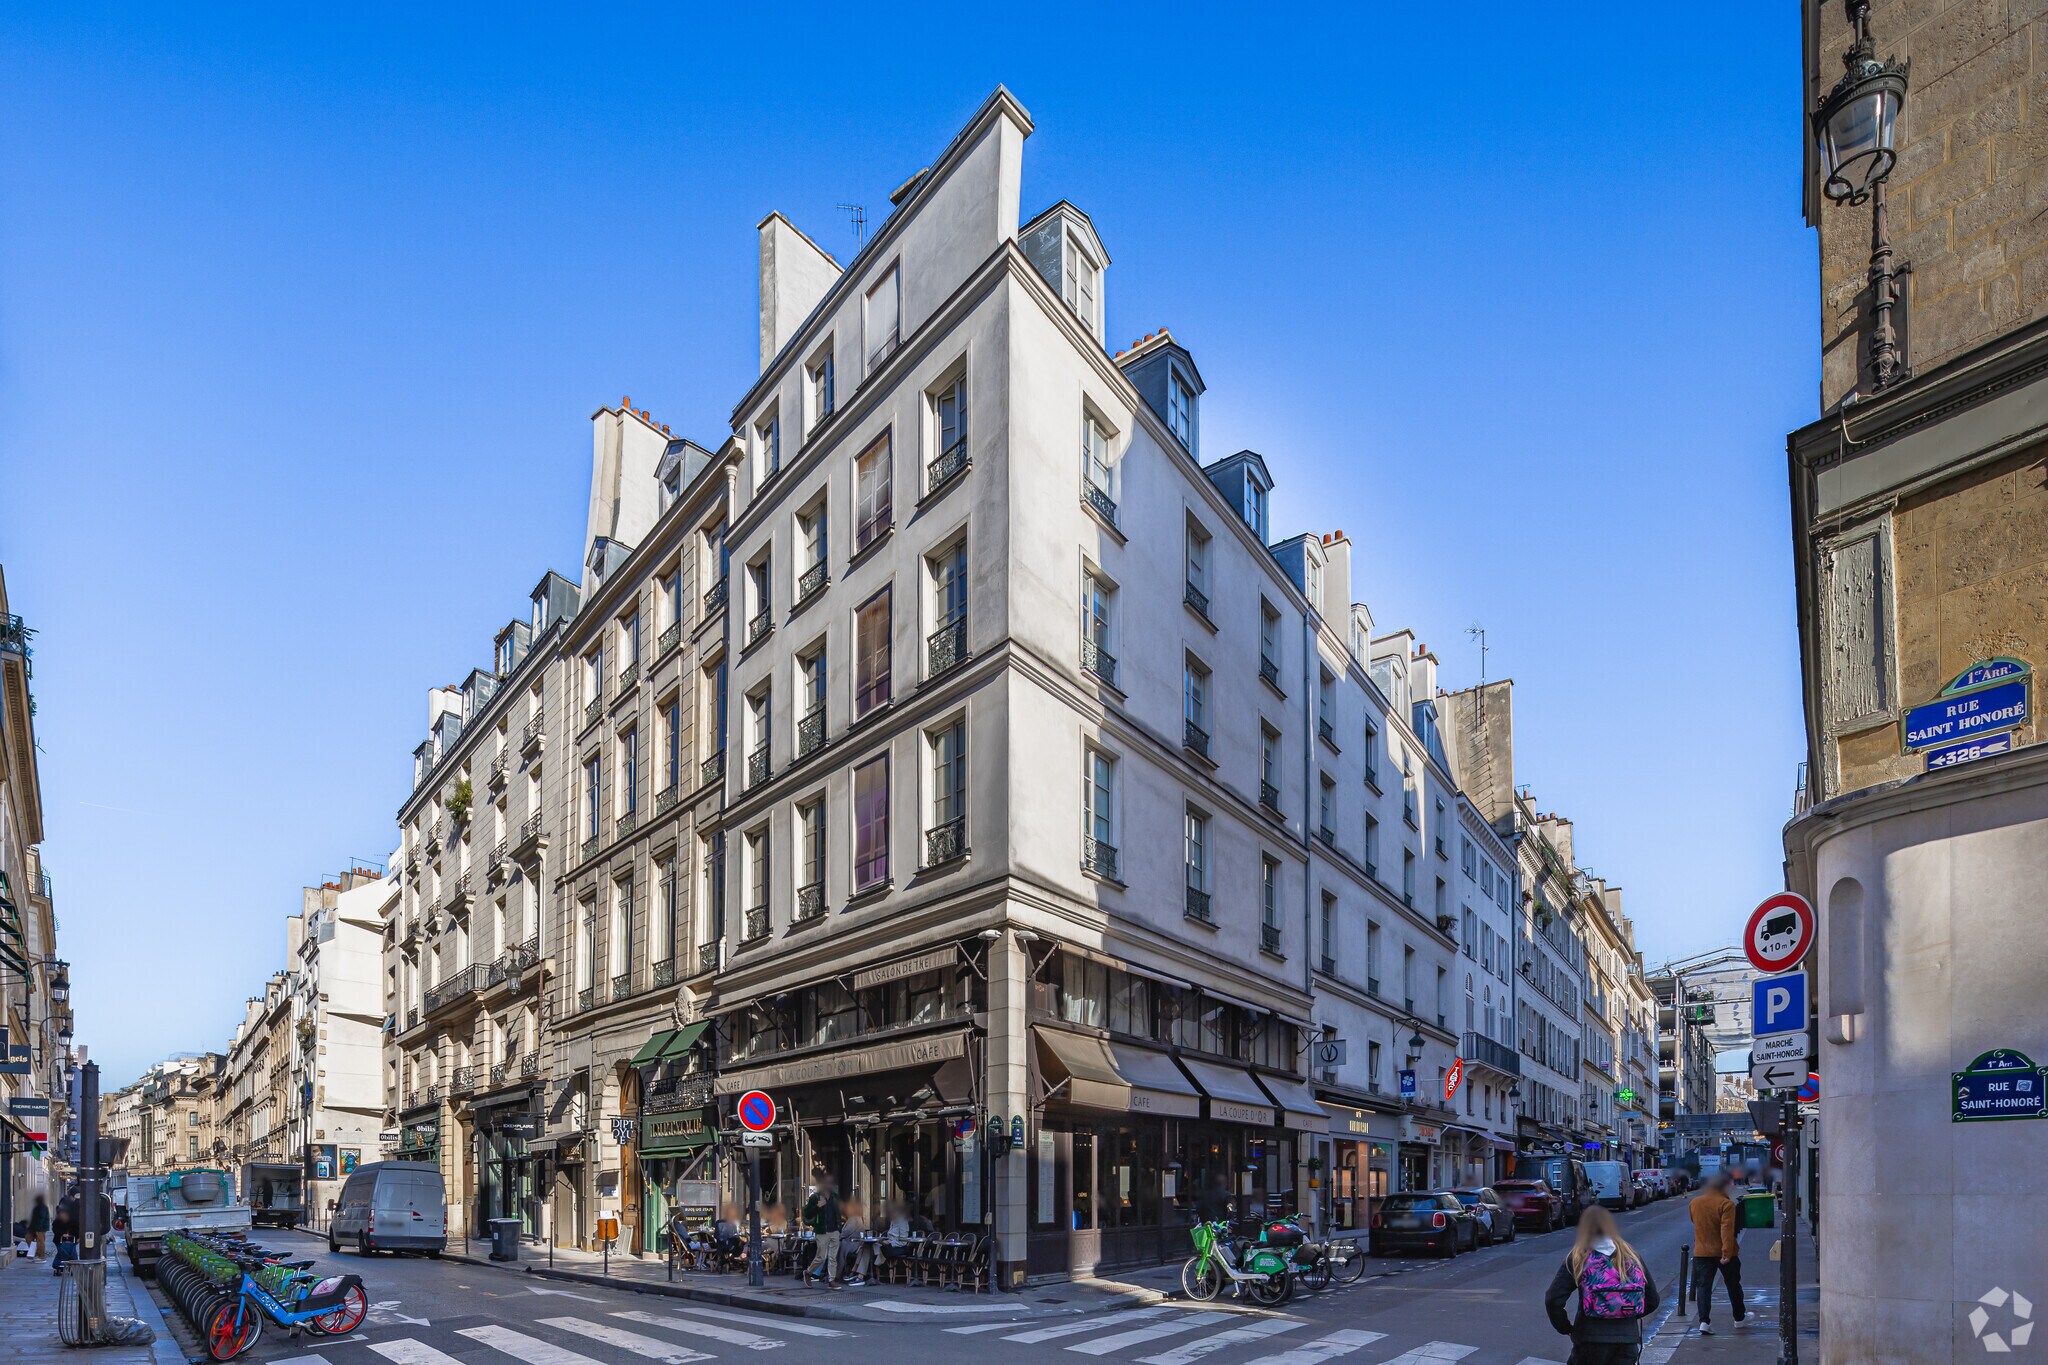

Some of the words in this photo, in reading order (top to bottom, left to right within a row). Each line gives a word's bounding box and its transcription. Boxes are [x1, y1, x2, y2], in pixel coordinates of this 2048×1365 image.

[1946, 699, 1980, 718] RUE
[1907, 722, 1954, 743] SAINT
[1958, 701, 2025, 730] HONORÉ
[1945, 746, 1981, 765] 326
[1769, 942, 1781, 952] 10
[876, 965, 901, 981] SALON
[902, 962, 913, 974] DE
[1766, 986, 1791, 1025] P
[1765, 1037, 1794, 1049] MARCHÉ
[916, 1046, 938, 1060] CAFE
[1756, 1047, 1804, 1061] SAINT-HONORÉ
[784, 1071, 794, 1082] LA
[796, 1066, 824, 1080] COUPE
[1448, 1066, 1460, 1090] TABAC
[726, 1081, 740, 1091] CAFE
[1988, 1082, 2010, 1092] RUE
[1134, 1096, 1150, 1108] CAFE
[1961, 1095, 2041, 1110] SAINT-HONORÉ
[1219, 1106, 1228, 1116] LA
[1229, 1107, 1249, 1120] COUPE
[1302, 1120, 1312, 1128] CAFE
